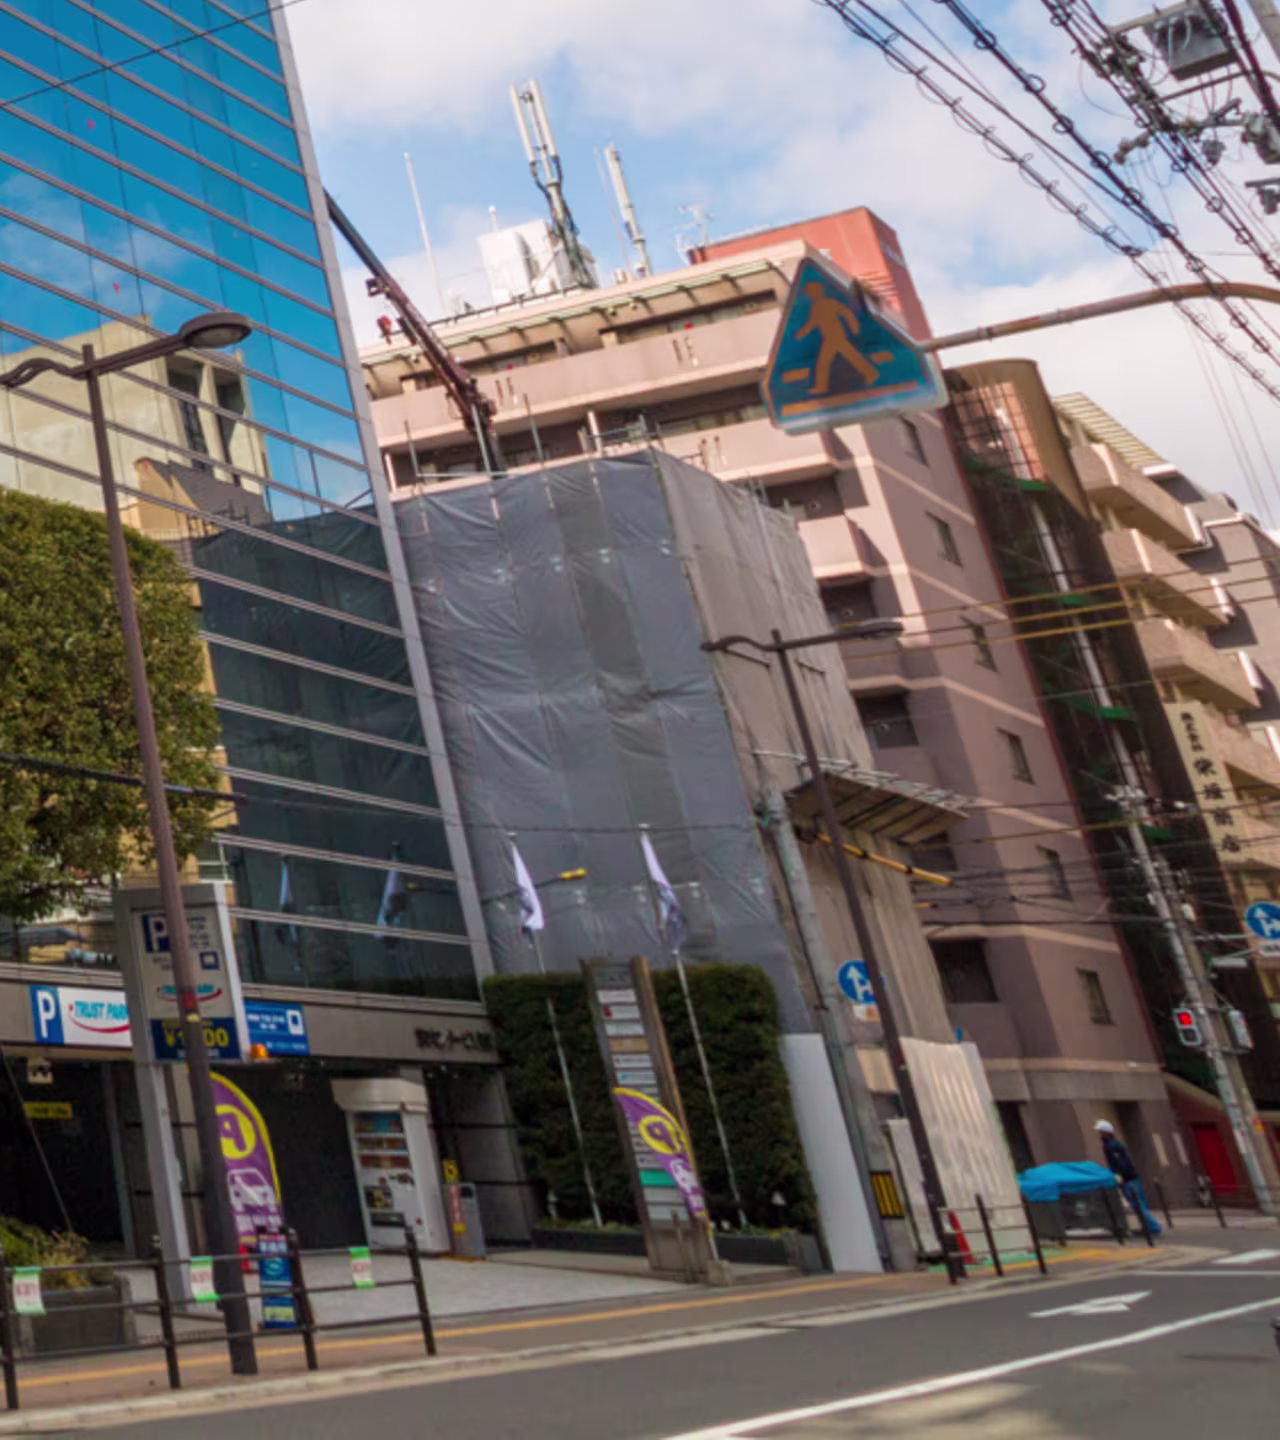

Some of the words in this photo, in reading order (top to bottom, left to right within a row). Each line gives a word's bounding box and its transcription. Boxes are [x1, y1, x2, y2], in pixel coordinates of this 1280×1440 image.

[36, 990, 56, 1038] P
[74, 1001, 104, 1019] TRUST
[107, 1002, 128, 1021] PAR
